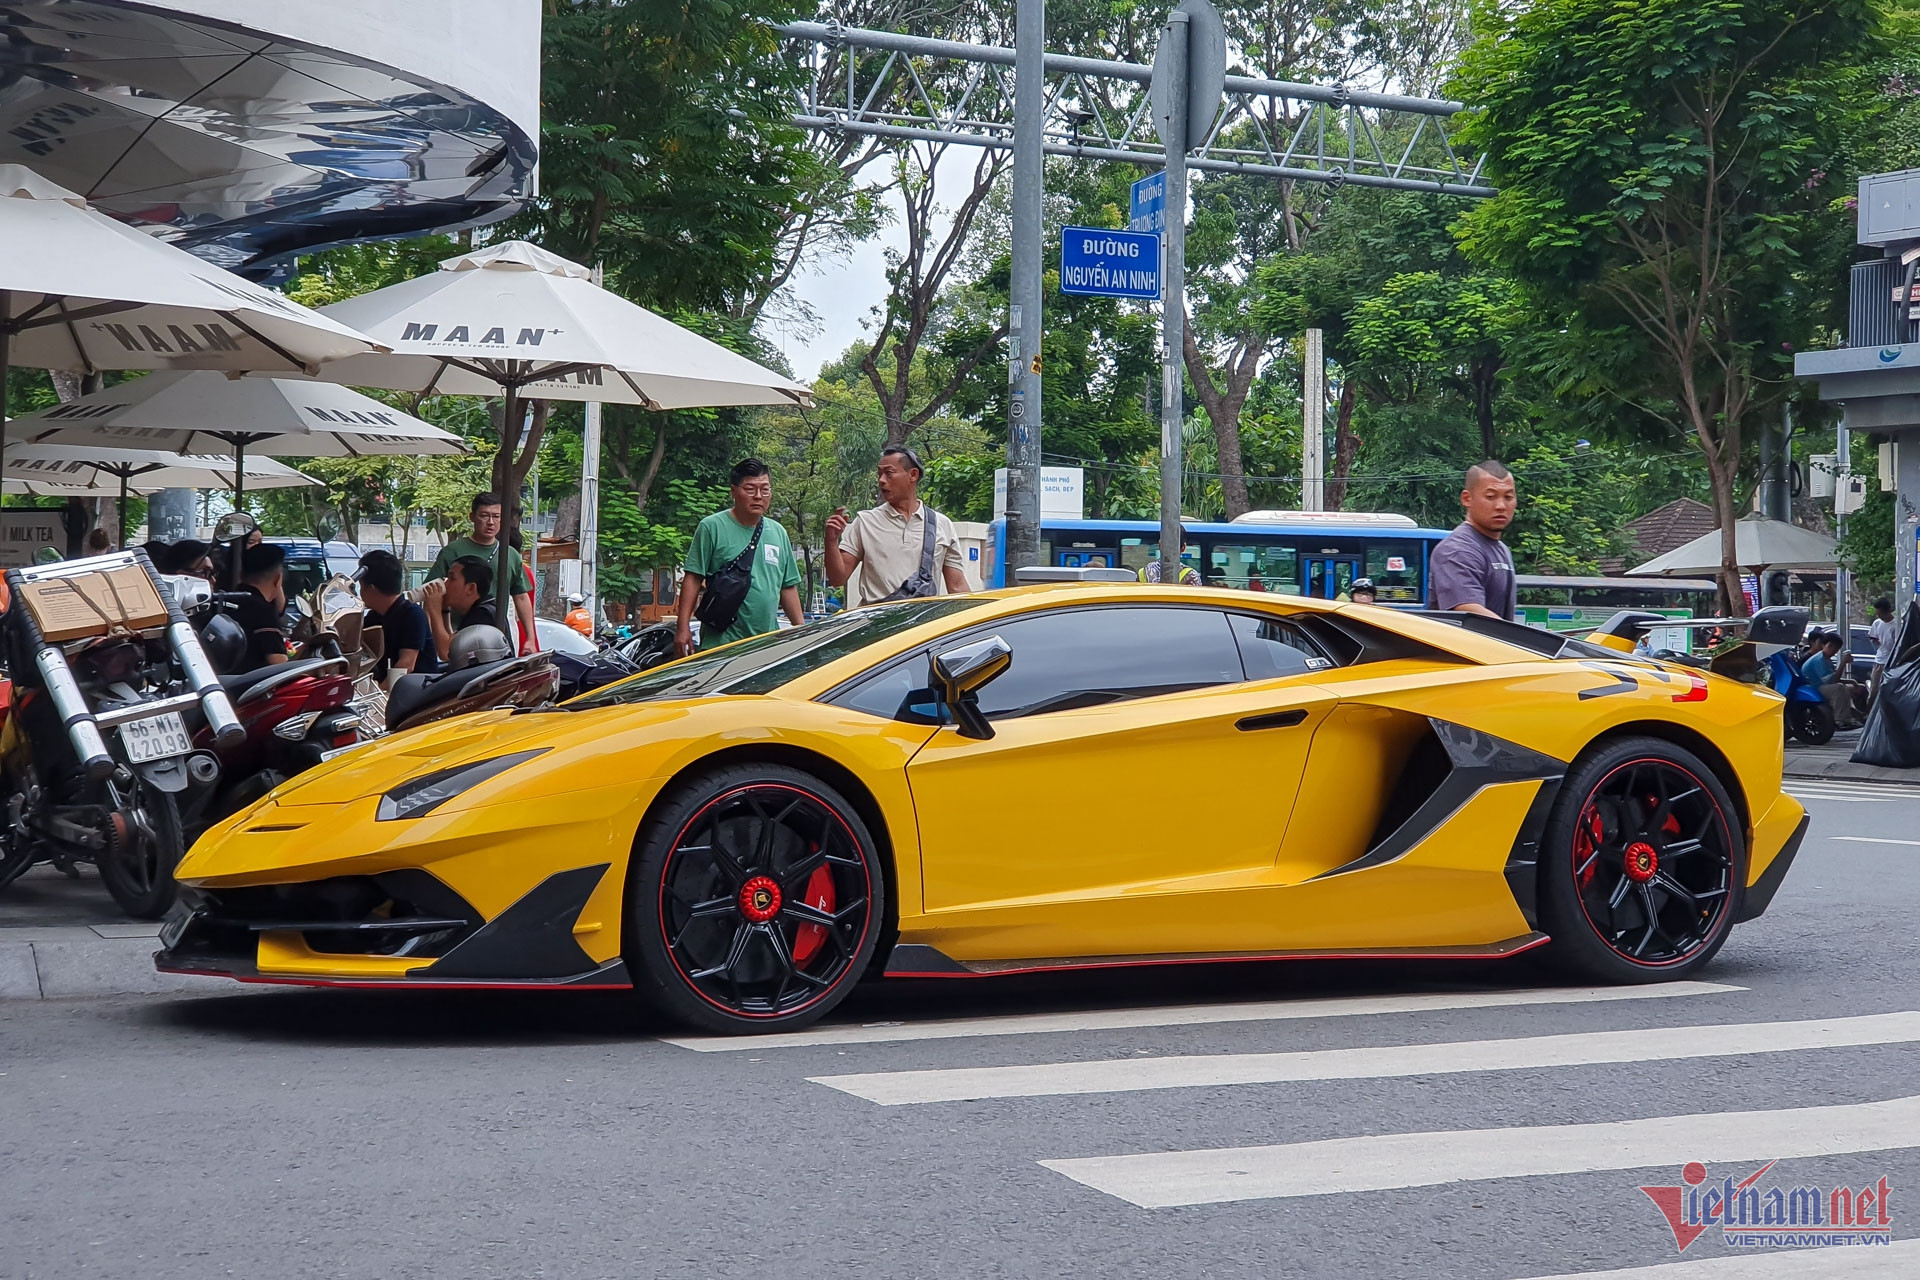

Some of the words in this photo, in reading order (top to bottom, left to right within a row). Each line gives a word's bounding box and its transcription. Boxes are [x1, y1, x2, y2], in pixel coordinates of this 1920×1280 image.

[1083, 237, 1139, 257] ĐƯỜNG
[1065, 261, 1109, 288] NGUYỄN
[1111, 269, 1127, 289] AN
[1129, 270, 1156, 291] NINH
[10, 527, 34, 541] MILK
[36, 527, 54, 541] TEA
[131, 733, 188, 759] 420.98
